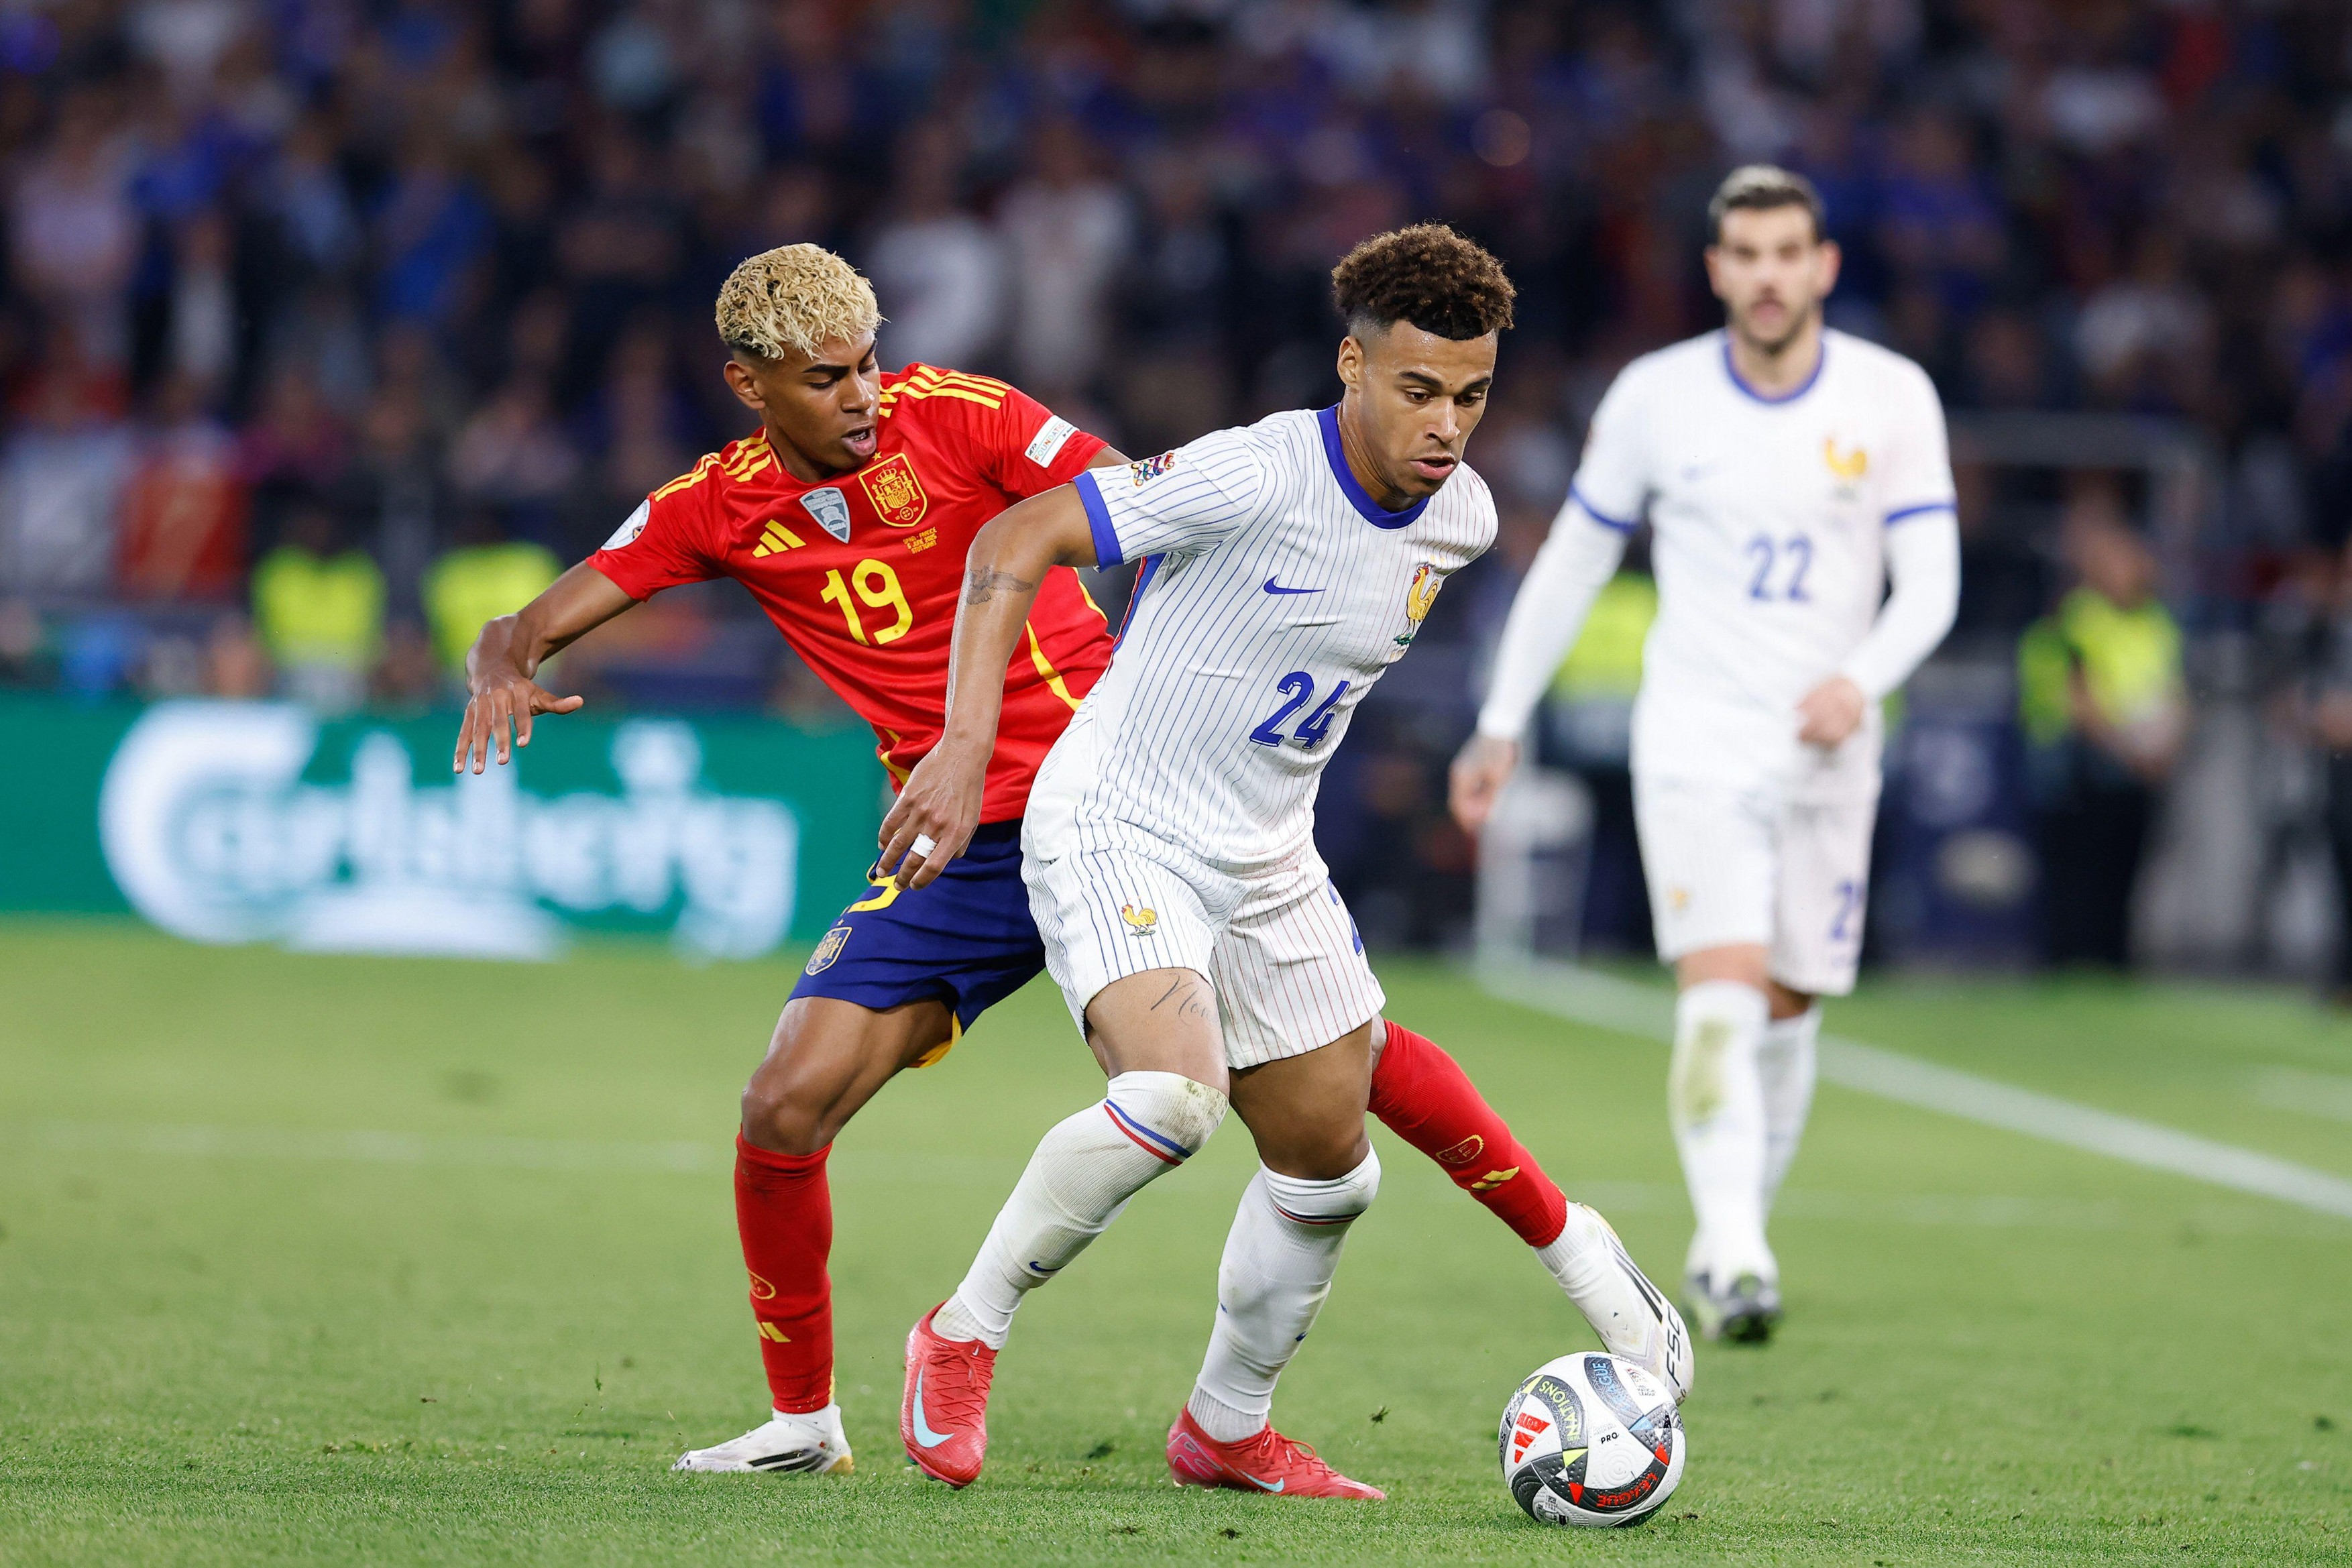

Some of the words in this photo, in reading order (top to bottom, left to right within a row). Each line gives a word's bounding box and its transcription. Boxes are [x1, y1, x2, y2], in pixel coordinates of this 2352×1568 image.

[1034, 421, 1066, 461] FOUNDATIO
[1747, 533, 1813, 602] 22
[820, 558, 913, 647] 19
[1249, 671, 1351, 749] 24
[1538, 1380, 1581, 1437] NATIONS
[1600, 1432, 1618, 1445] PRO
[1595, 1472, 1658, 1508] LEAGUE
